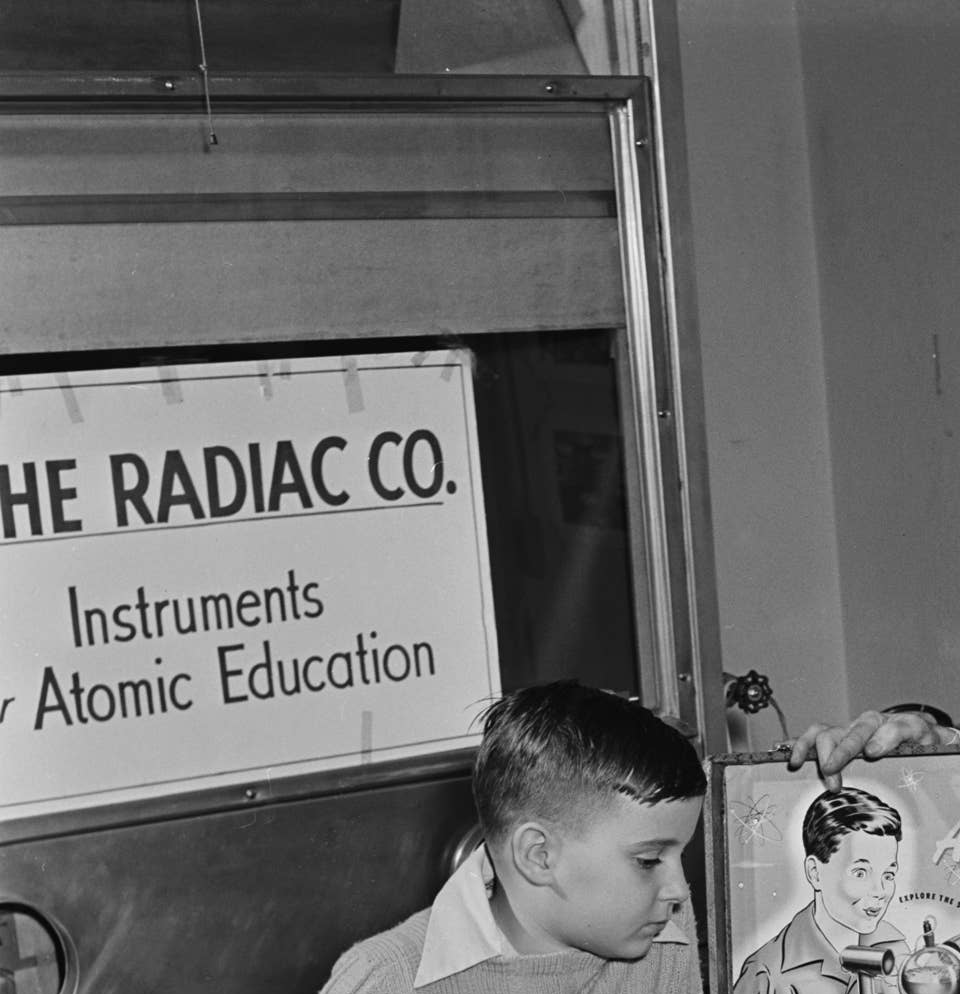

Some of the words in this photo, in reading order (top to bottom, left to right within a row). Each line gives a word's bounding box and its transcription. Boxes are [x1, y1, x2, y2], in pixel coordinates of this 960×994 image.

[109, 435, 351, 528] RADIAC
[367, 428, 458, 502] CO.
[67, 569, 325, 648] Instruments
[33, 657, 194, 731] Atomic
[216, 630, 437, 705] Education
[899, 892, 937, 903] EXPLORE
